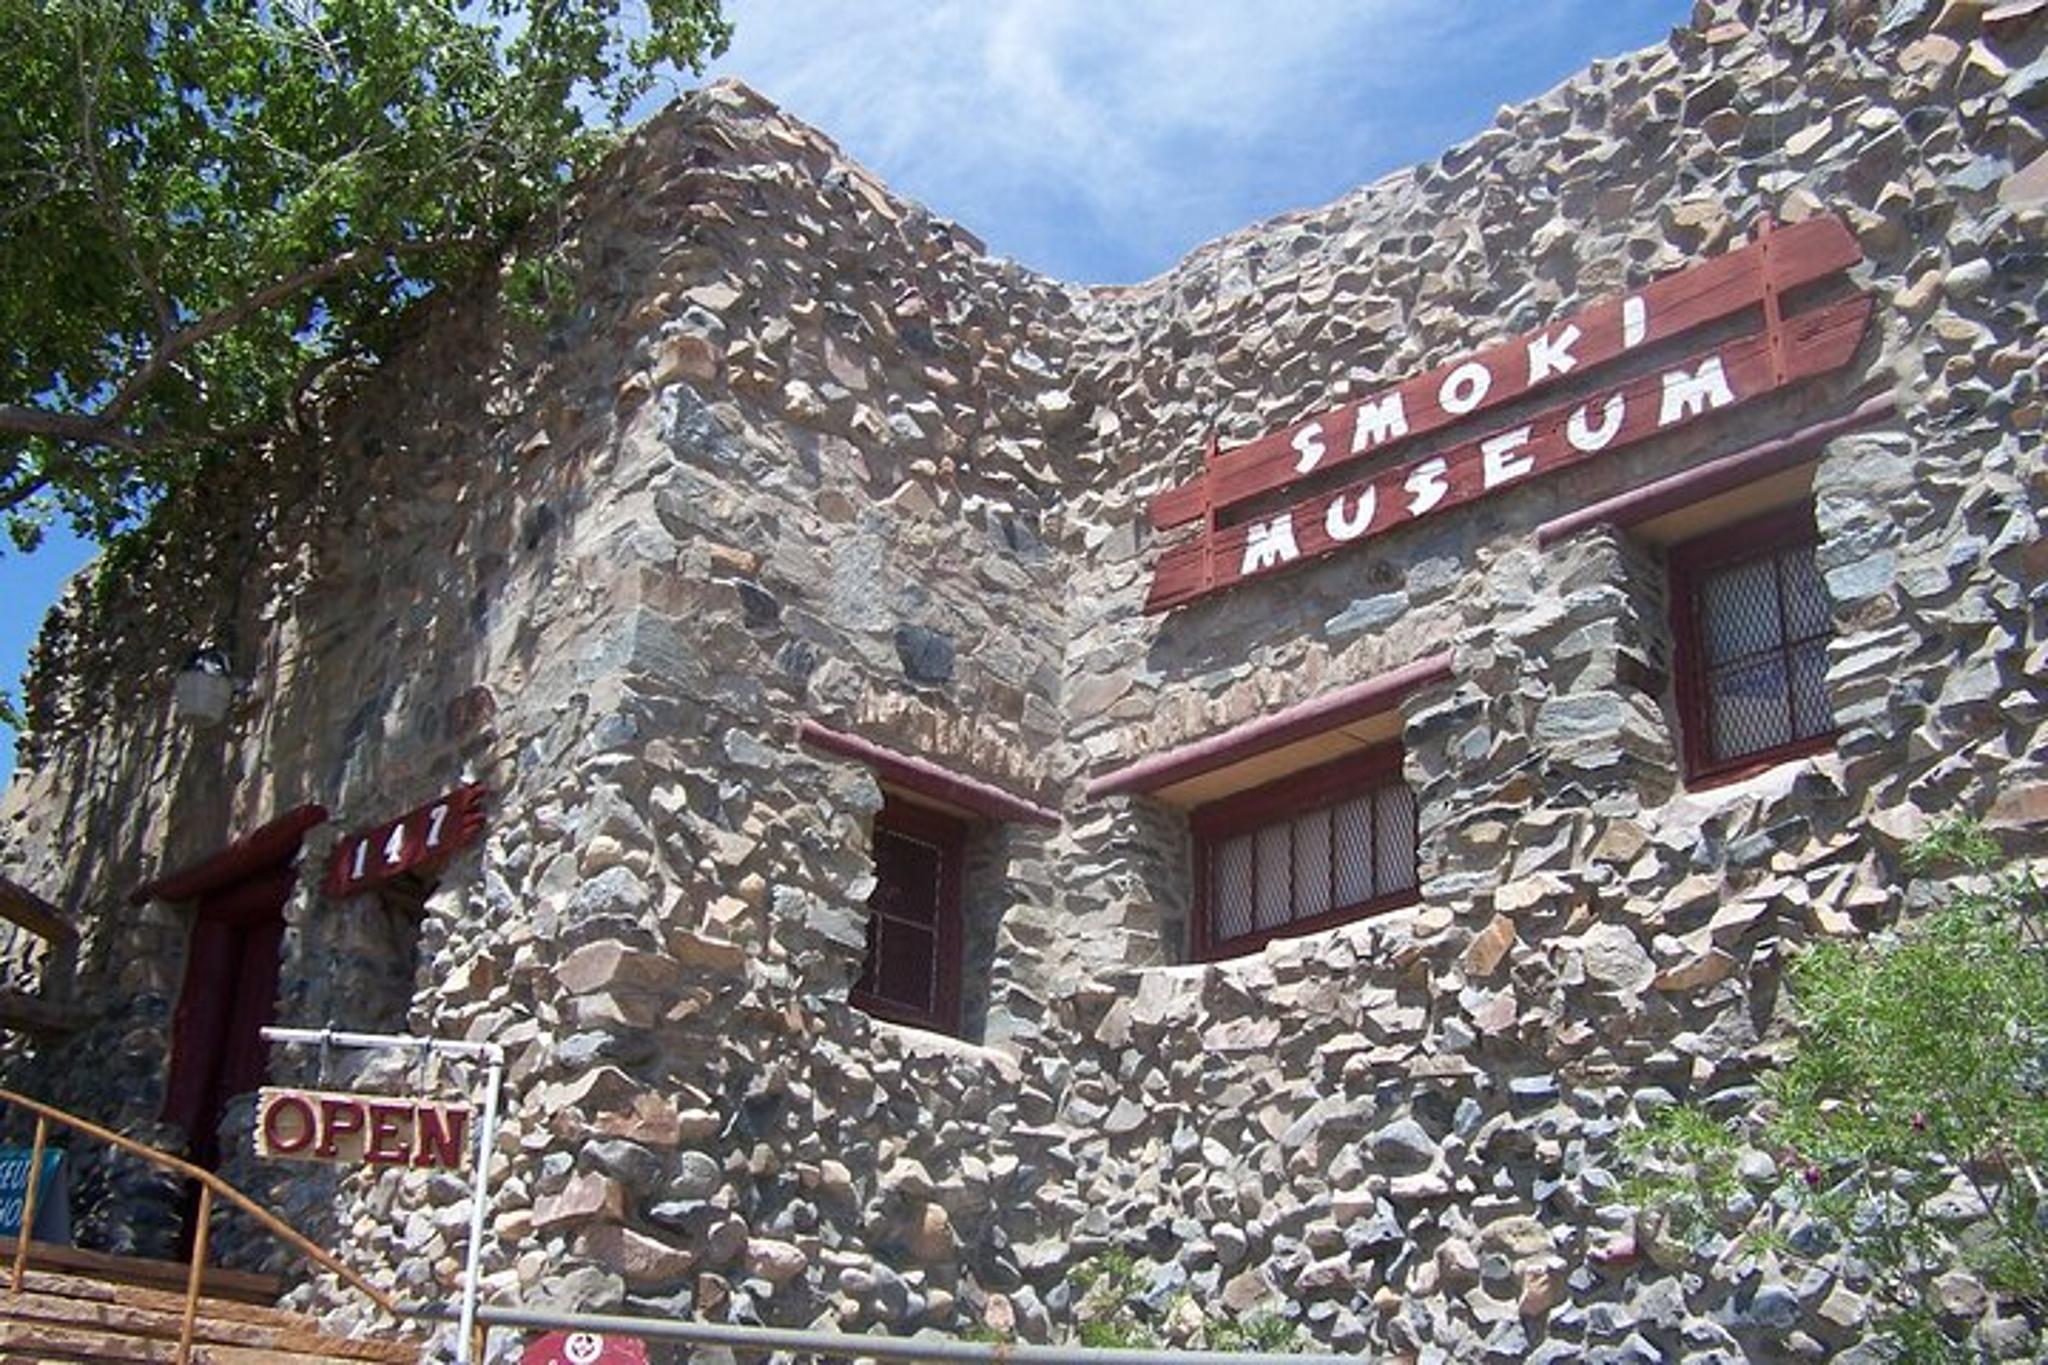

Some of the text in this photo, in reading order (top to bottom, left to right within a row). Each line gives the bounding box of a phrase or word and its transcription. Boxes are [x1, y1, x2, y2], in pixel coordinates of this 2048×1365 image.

[1291, 298, 1646, 474] SMOKI
[1241, 357, 1733, 574] MUSEUM
[351, 804, 449, 880] 147
[264, 1094, 470, 1168] OPEN
